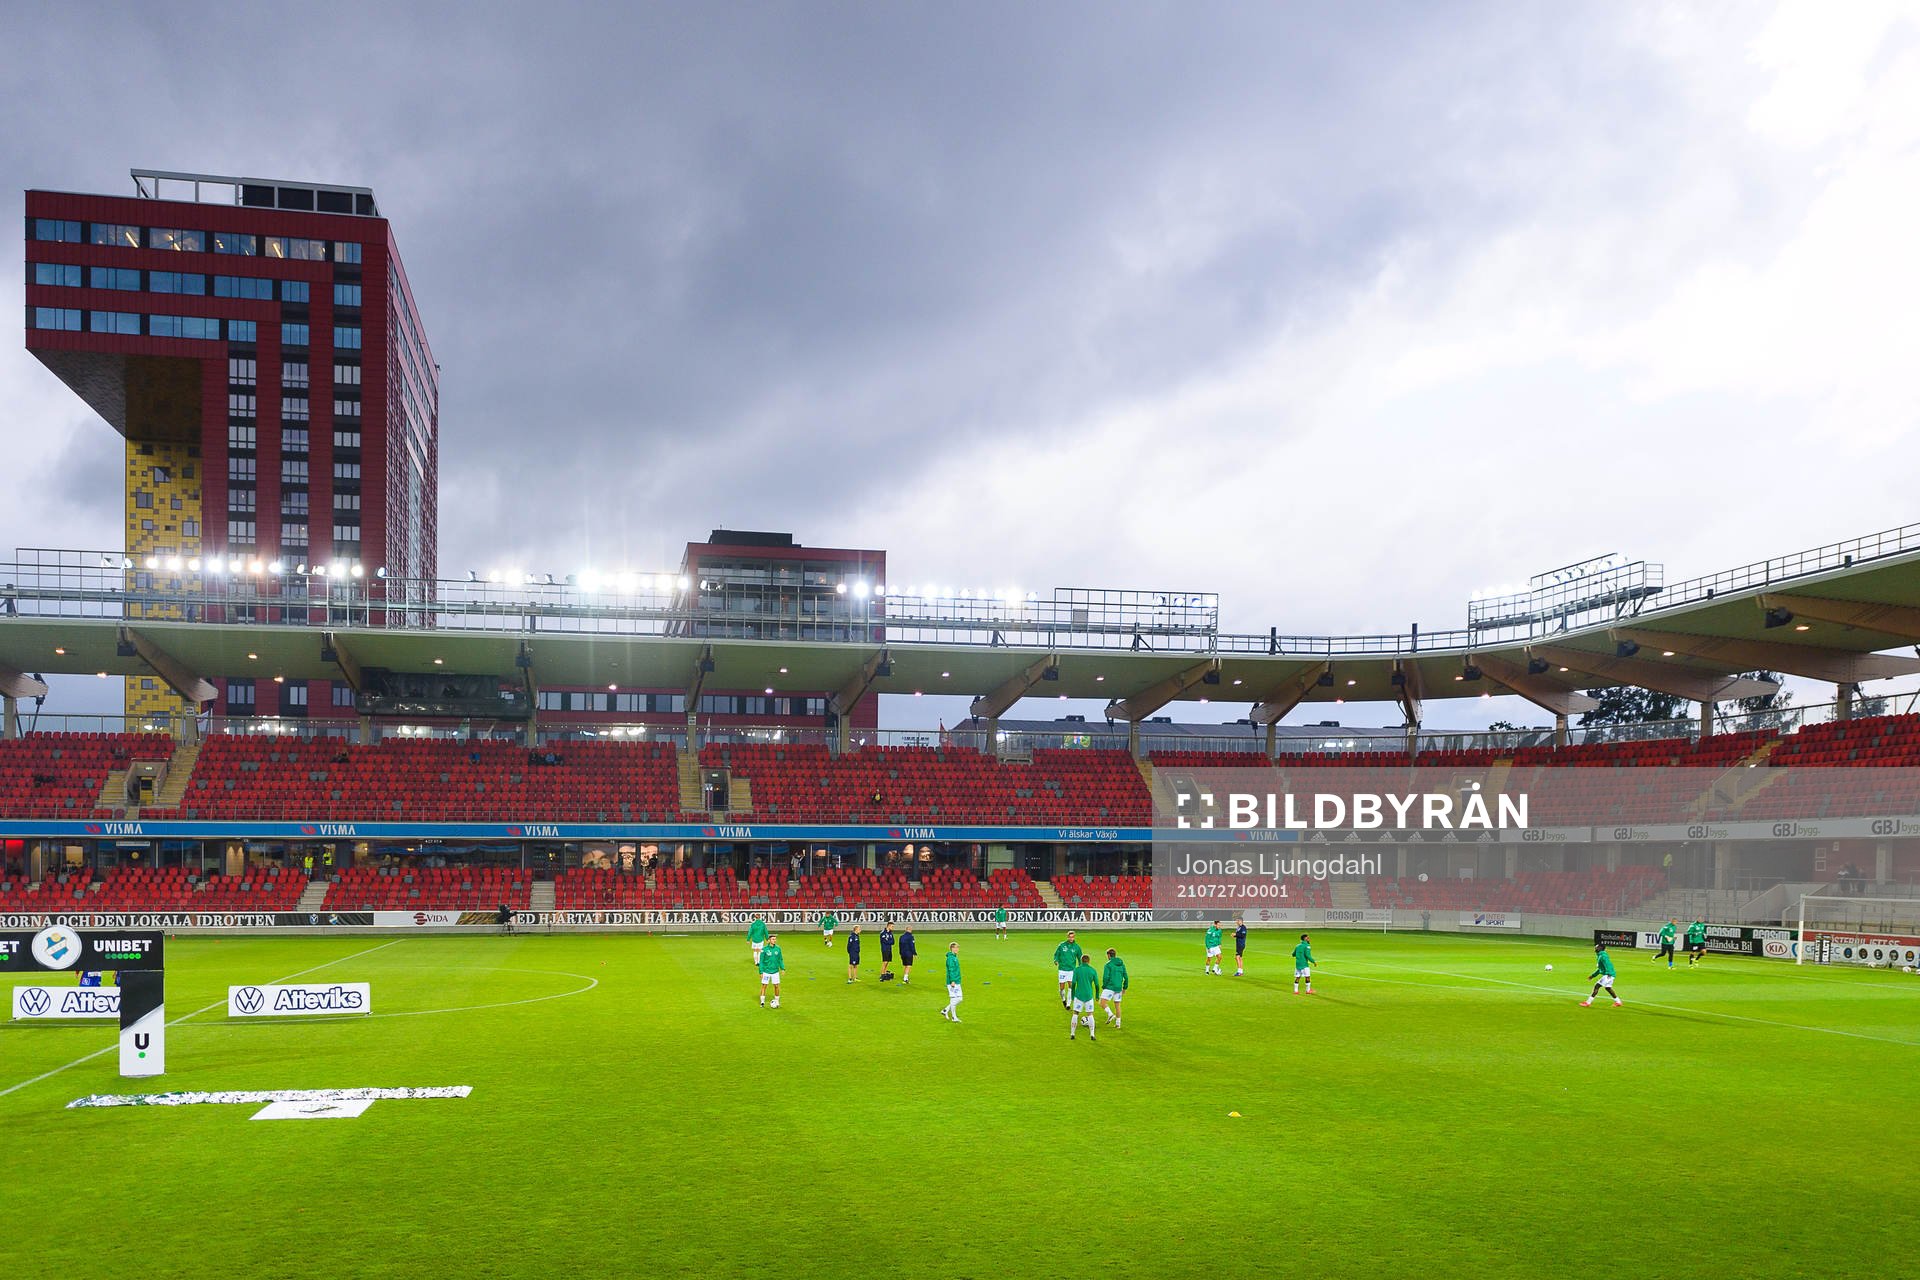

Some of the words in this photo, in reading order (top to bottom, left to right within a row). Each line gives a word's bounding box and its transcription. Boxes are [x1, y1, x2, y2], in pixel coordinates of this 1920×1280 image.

[105, 824, 143, 834] VISMA
[320, 824, 356, 835] VISMA
[525, 826, 559, 836] VISMA
[719, 827, 752, 837] VISMA
[1688, 826, 1709, 838] GBJ
[1773, 823, 1798, 837] GBJ
[1871, 820, 1900, 834] GBJ
[904, 828, 936, 839] VISMA
[1058, 830, 1067, 838] Vi
[1069, 829, 1093, 838] älskar
[1096, 830, 1118, 840] Växjö
[1250, 831, 1279, 841] VISMA
[1522, 830, 1545, 841] GBJ
[1614, 828, 1632, 839] GBJ
[57, 915, 90, 927] OCH
[94, 915, 126, 927] DEN
[131, 914, 192, 927] LOKALA
[197, 914, 276, 926] IDROTTEN
[428, 915, 448, 923] VIDA
[539, 911, 602, 924] HJÄRTAT
[605, 913, 611, 924] I
[613, 913, 642, 924] DEN
[647, 910, 719, 924] HÅLLBARA
[784, 912, 801, 923] DE
[888, 910, 974, 923] TRÄVARORNA
[978, 912, 995, 922] OC
[1008, 911, 1034, 922] DEN
[1037, 911, 1086, 922] LOKALA
[1090, 911, 1153, 922] IDROTTEN
[94, 940, 152, 951] UNIBET
[1769, 945, 1784, 953] KIA
[274, 986, 362, 1010] Atteviks
[135, 1033, 149, 1050] U
